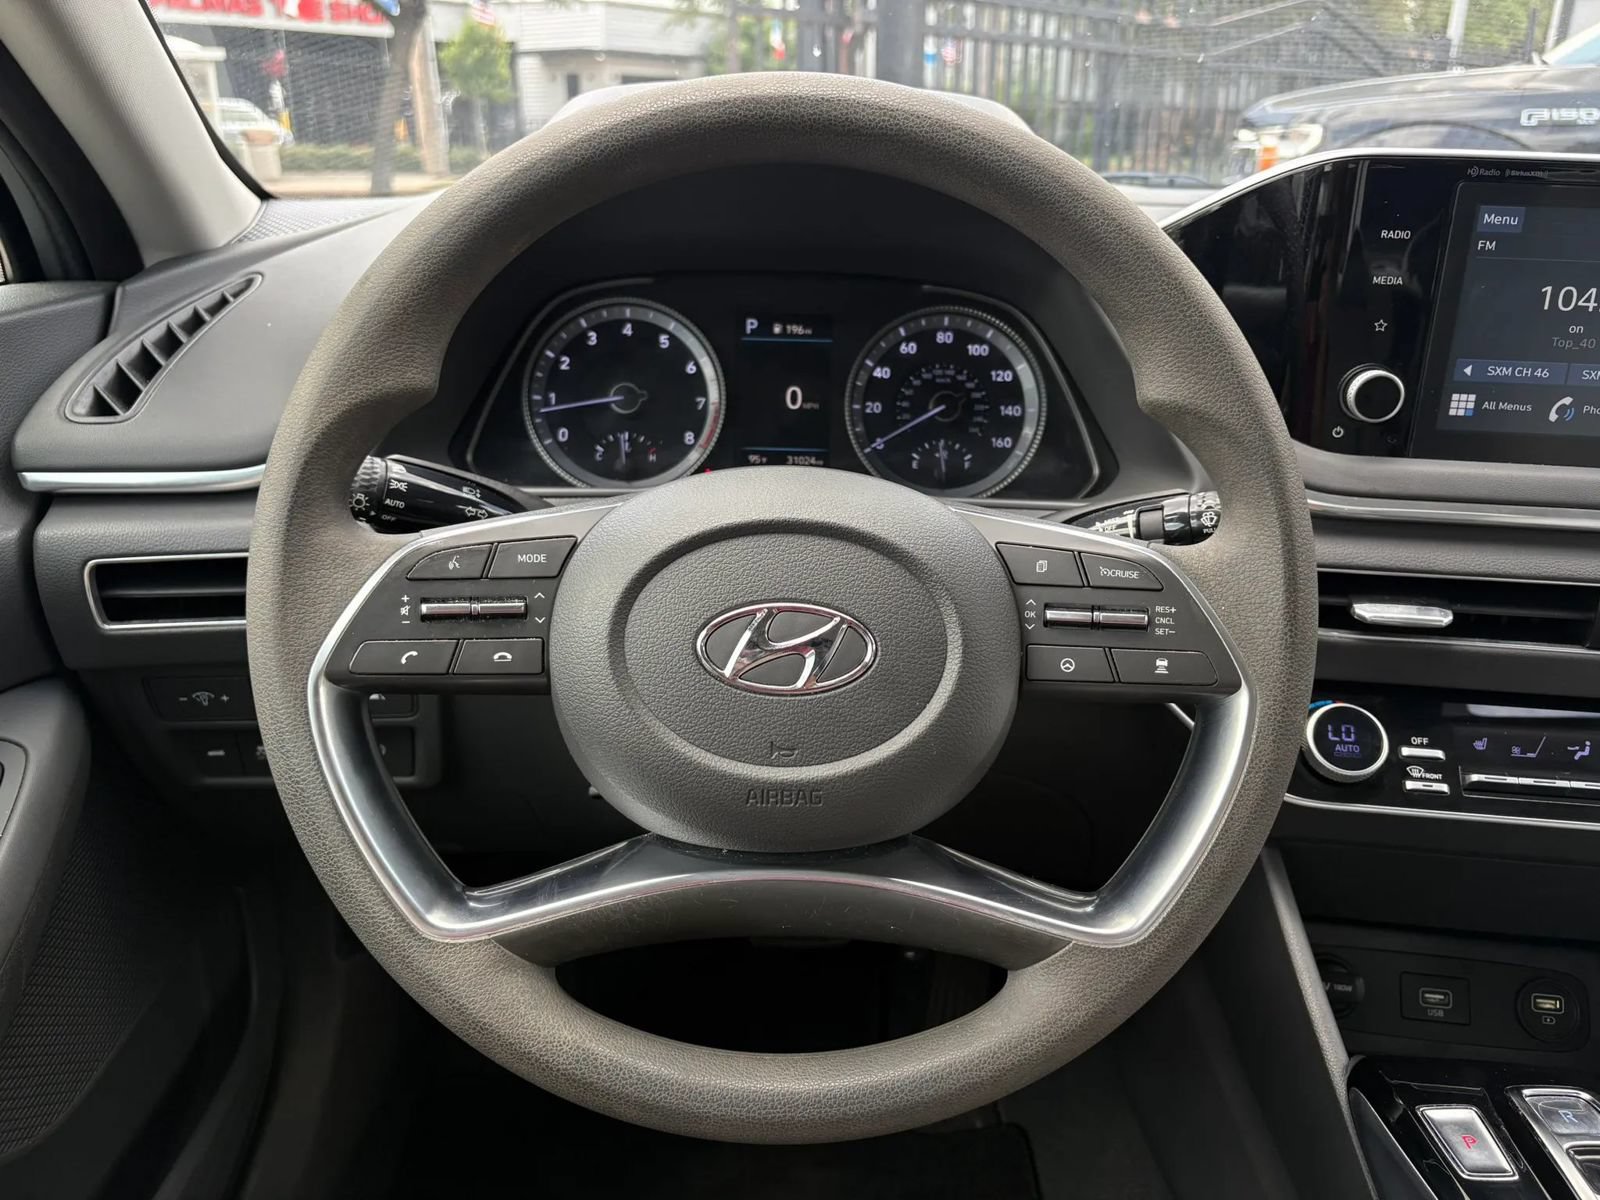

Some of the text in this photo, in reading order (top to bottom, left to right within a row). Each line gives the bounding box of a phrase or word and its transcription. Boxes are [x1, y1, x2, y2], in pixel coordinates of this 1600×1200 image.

[1483, 213, 1519, 226] Menu
[1380, 229, 1412, 240] RADIO
[1477, 240, 1496, 251] FM
[1372, 275, 1404, 286] MEDIA
[622, 323, 633, 337] 4
[745, 318, 759, 335] P
[1568, 325, 1584, 334] on
[587, 332, 598, 346] 3
[659, 335, 670, 349] 5
[936, 331, 954, 344] 80
[1551, 336, 1597, 350] Top_40
[900, 342, 918, 355] 60
[967, 344, 990, 357] 100
[559, 356, 571, 370] 2
[686, 361, 697, 375] 6
[872, 366, 892, 379] 40
[991, 370, 1013, 382] 120
[1487, 365, 1550, 379] SXM CH 46
[548, 392, 556, 406] 1
[695, 397, 706, 411] 7
[785, 385, 803, 410] 0
[865, 402, 882, 414] 20
[1000, 405, 1022, 417] 140
[1482, 401, 1533, 412] All Menus
[558, 428, 569, 443] 0
[684, 431, 695, 445] 8
[991, 436, 1013, 449] 160
[912, 459, 920, 470] E
[964, 459, 972, 470] F
[384, 498, 406, 509] AUTO
[517, 553, 548, 564] MODE
[1110, 568, 1141, 579] CRUISE
[1024, 610, 1036, 619] OK
[1155, 605, 1177, 614] RES+
[1155, 616, 1176, 625] CNCL
[1410, 736, 1430, 746] OFF
[1335, 743, 1361, 754] AUTO
[1421, 771, 1443, 780] FRONT
[745, 788, 824, 808] AIRBAG
[1427, 1008, 1445, 1018] USB
[1558, 1109, 1579, 1124] R
[1461, 1134, 1479, 1149] P
